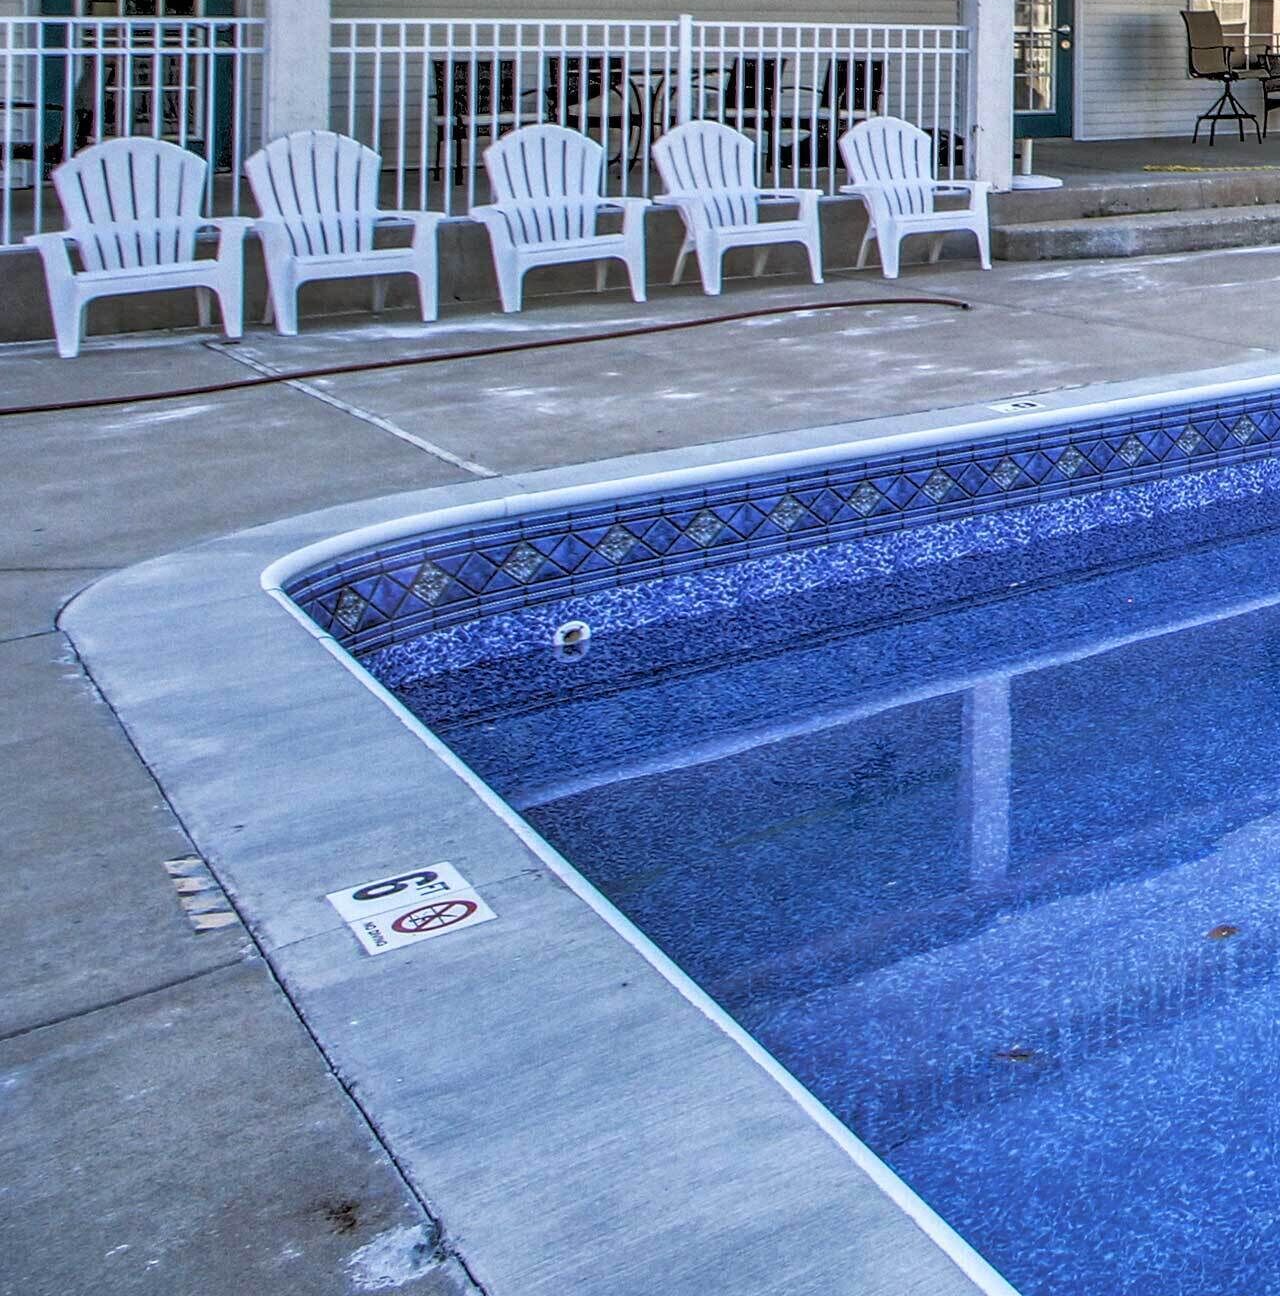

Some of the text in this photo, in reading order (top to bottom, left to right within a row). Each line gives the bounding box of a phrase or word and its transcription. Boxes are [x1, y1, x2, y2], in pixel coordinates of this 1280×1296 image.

[352, 871, 450, 901] 6 FT
[368, 929, 388, 947] DIVING
